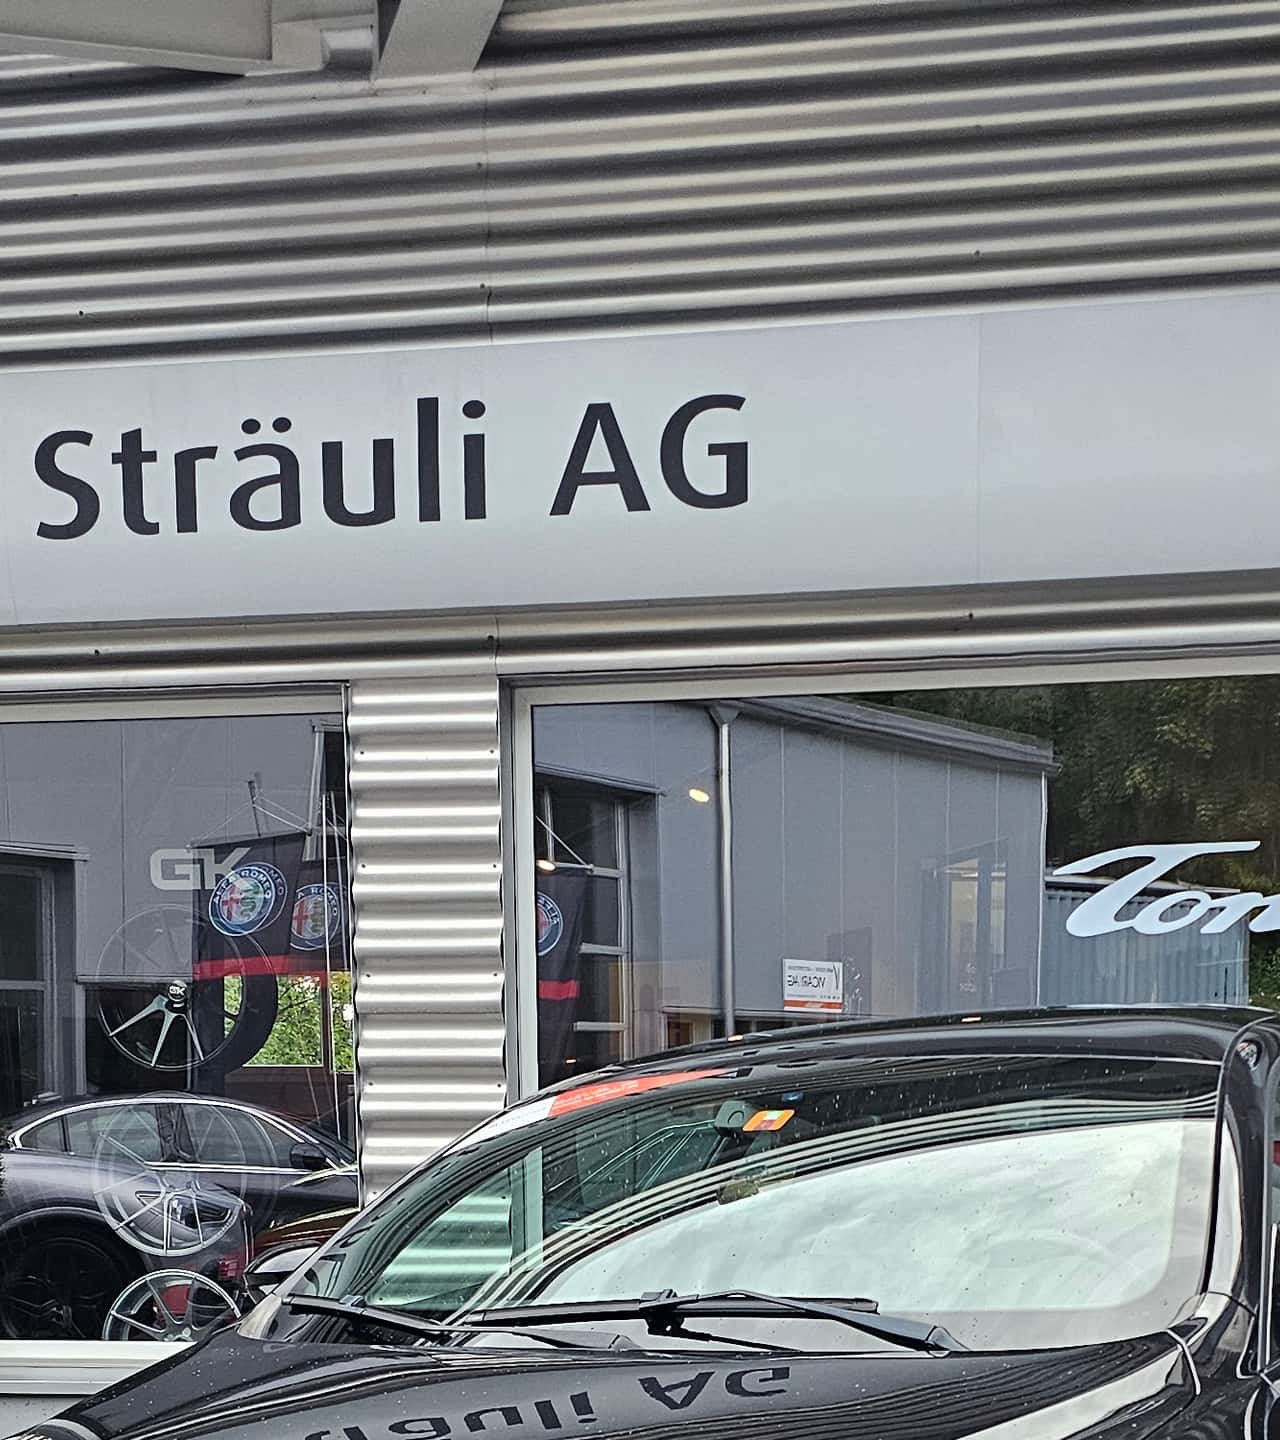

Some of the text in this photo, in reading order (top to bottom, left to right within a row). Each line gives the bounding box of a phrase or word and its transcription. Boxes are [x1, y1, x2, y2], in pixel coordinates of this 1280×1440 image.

[32, 396, 487, 541] Sträuli
[548, 393, 749, 517] AG
[149, 847, 251, 891] GK
